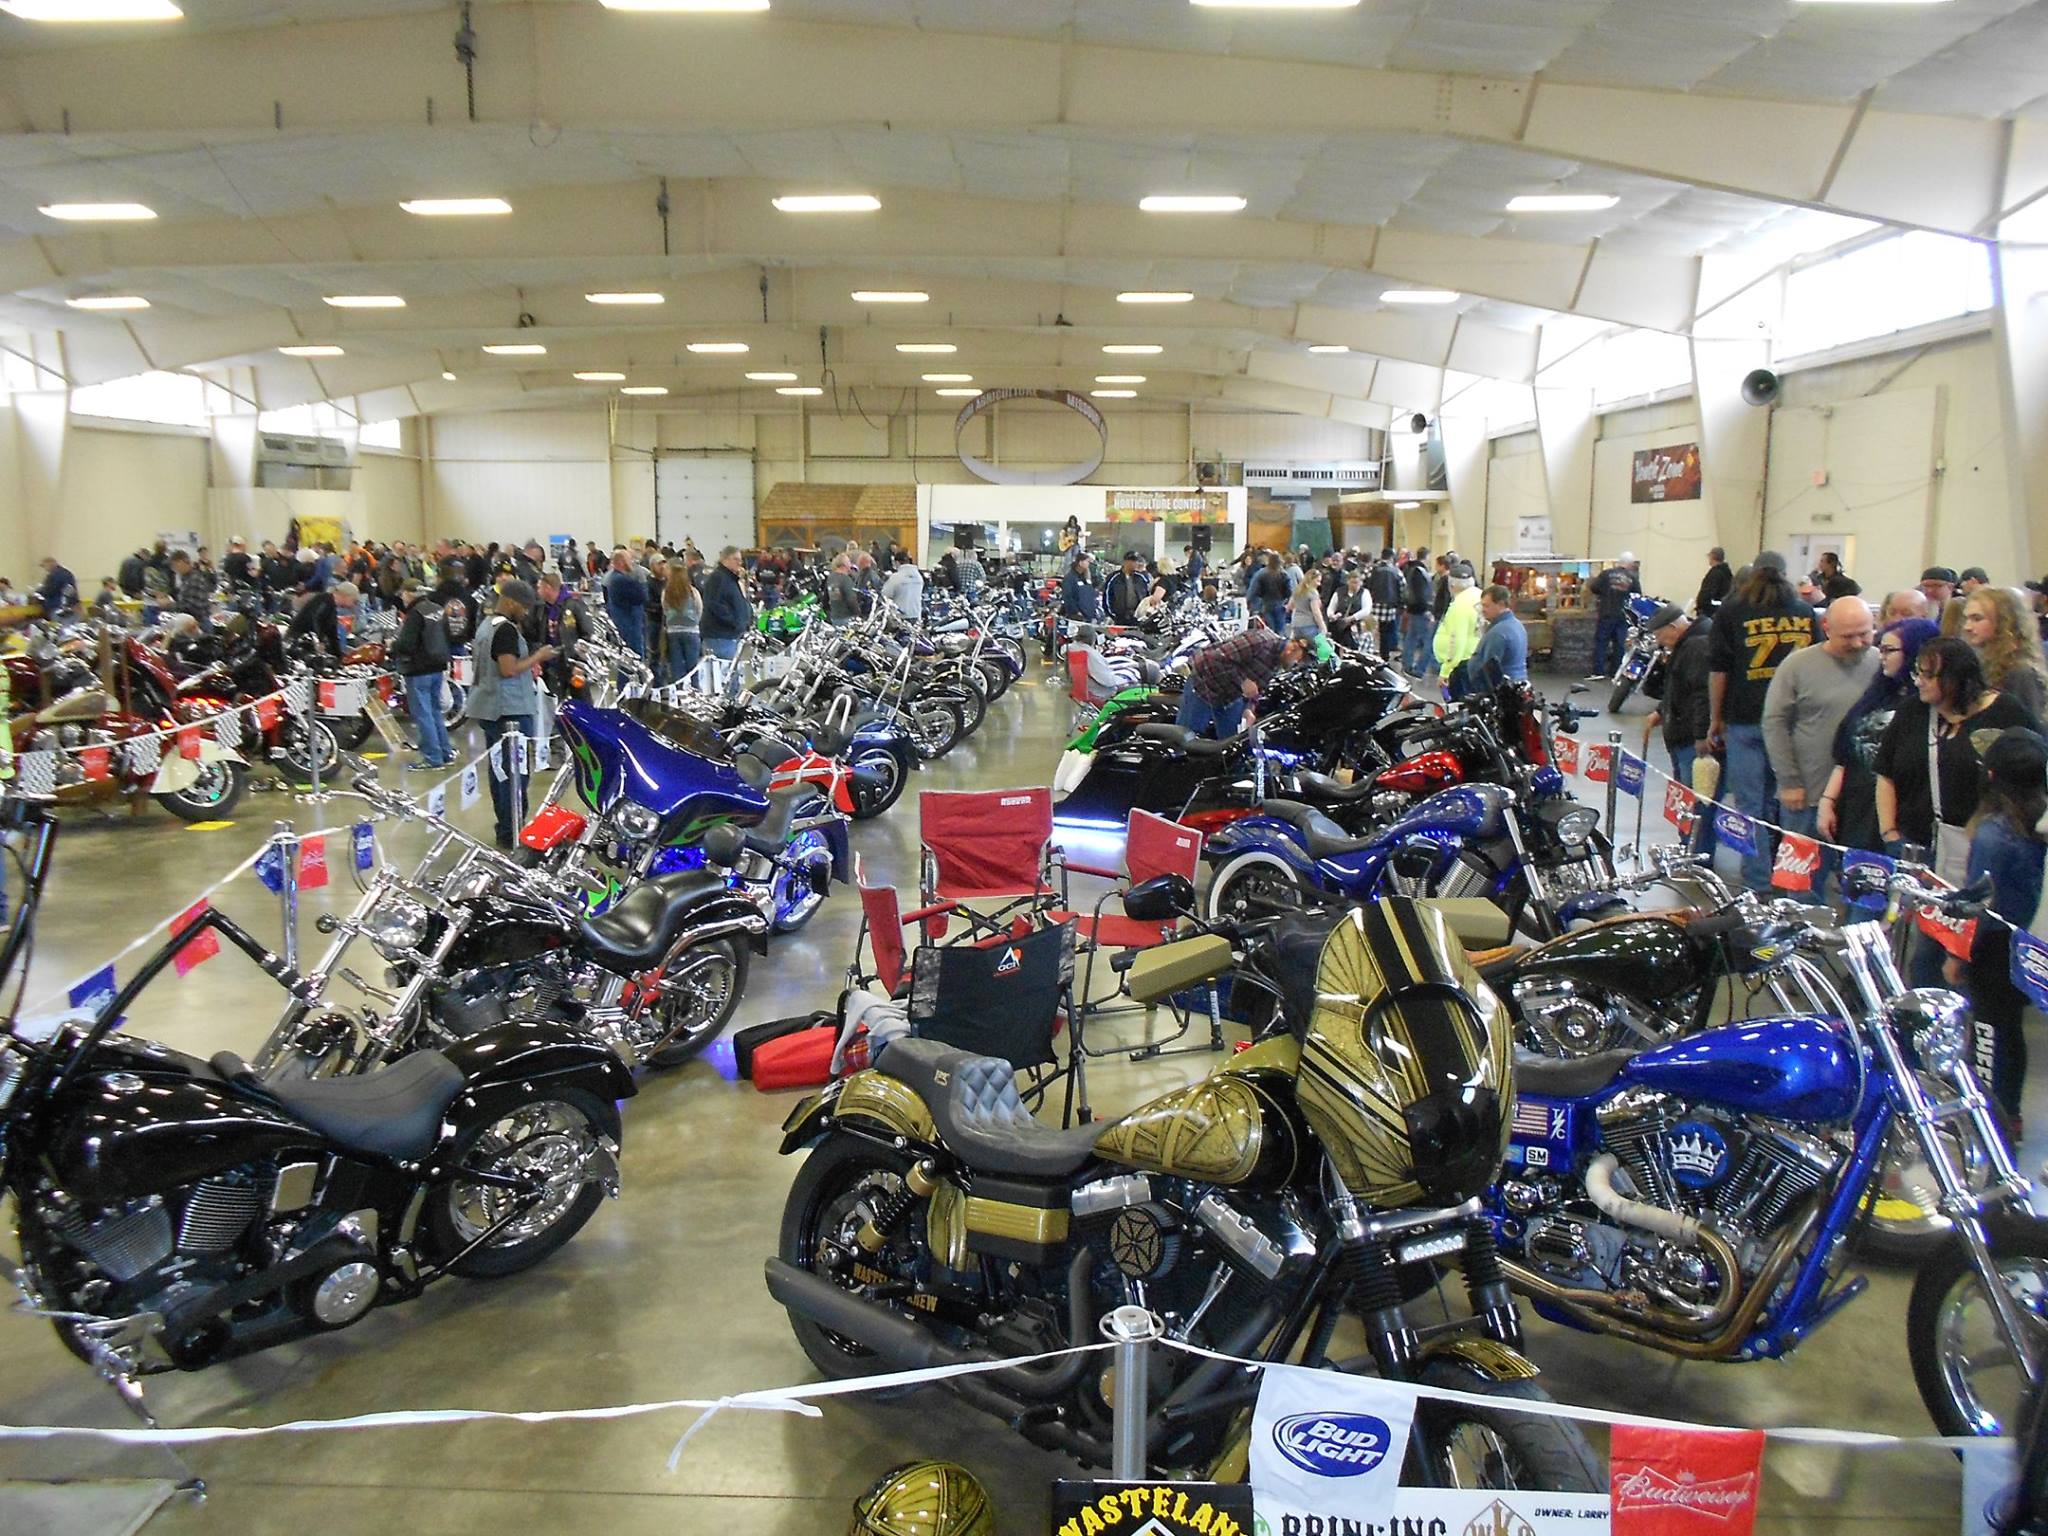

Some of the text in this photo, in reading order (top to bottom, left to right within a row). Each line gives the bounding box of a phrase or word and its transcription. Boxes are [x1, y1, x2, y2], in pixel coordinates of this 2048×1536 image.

[1114, 498, 1206, 510] HORTICULTURE CONTEST
[1743, 615, 1811, 634] TEAM
[1773, 843, 1815, 875] Bud
[1528, 1149, 1547, 1162] SM
[1307, 1420, 1379, 1448] BUD
[1287, 1431, 1384, 1466] LIGHT
[1614, 1472, 1751, 1505] Budweiser
[1056, 1486, 1249, 1536] WASTELAN
[1534, 1508, 1609, 1520] OWNER: LARRY
